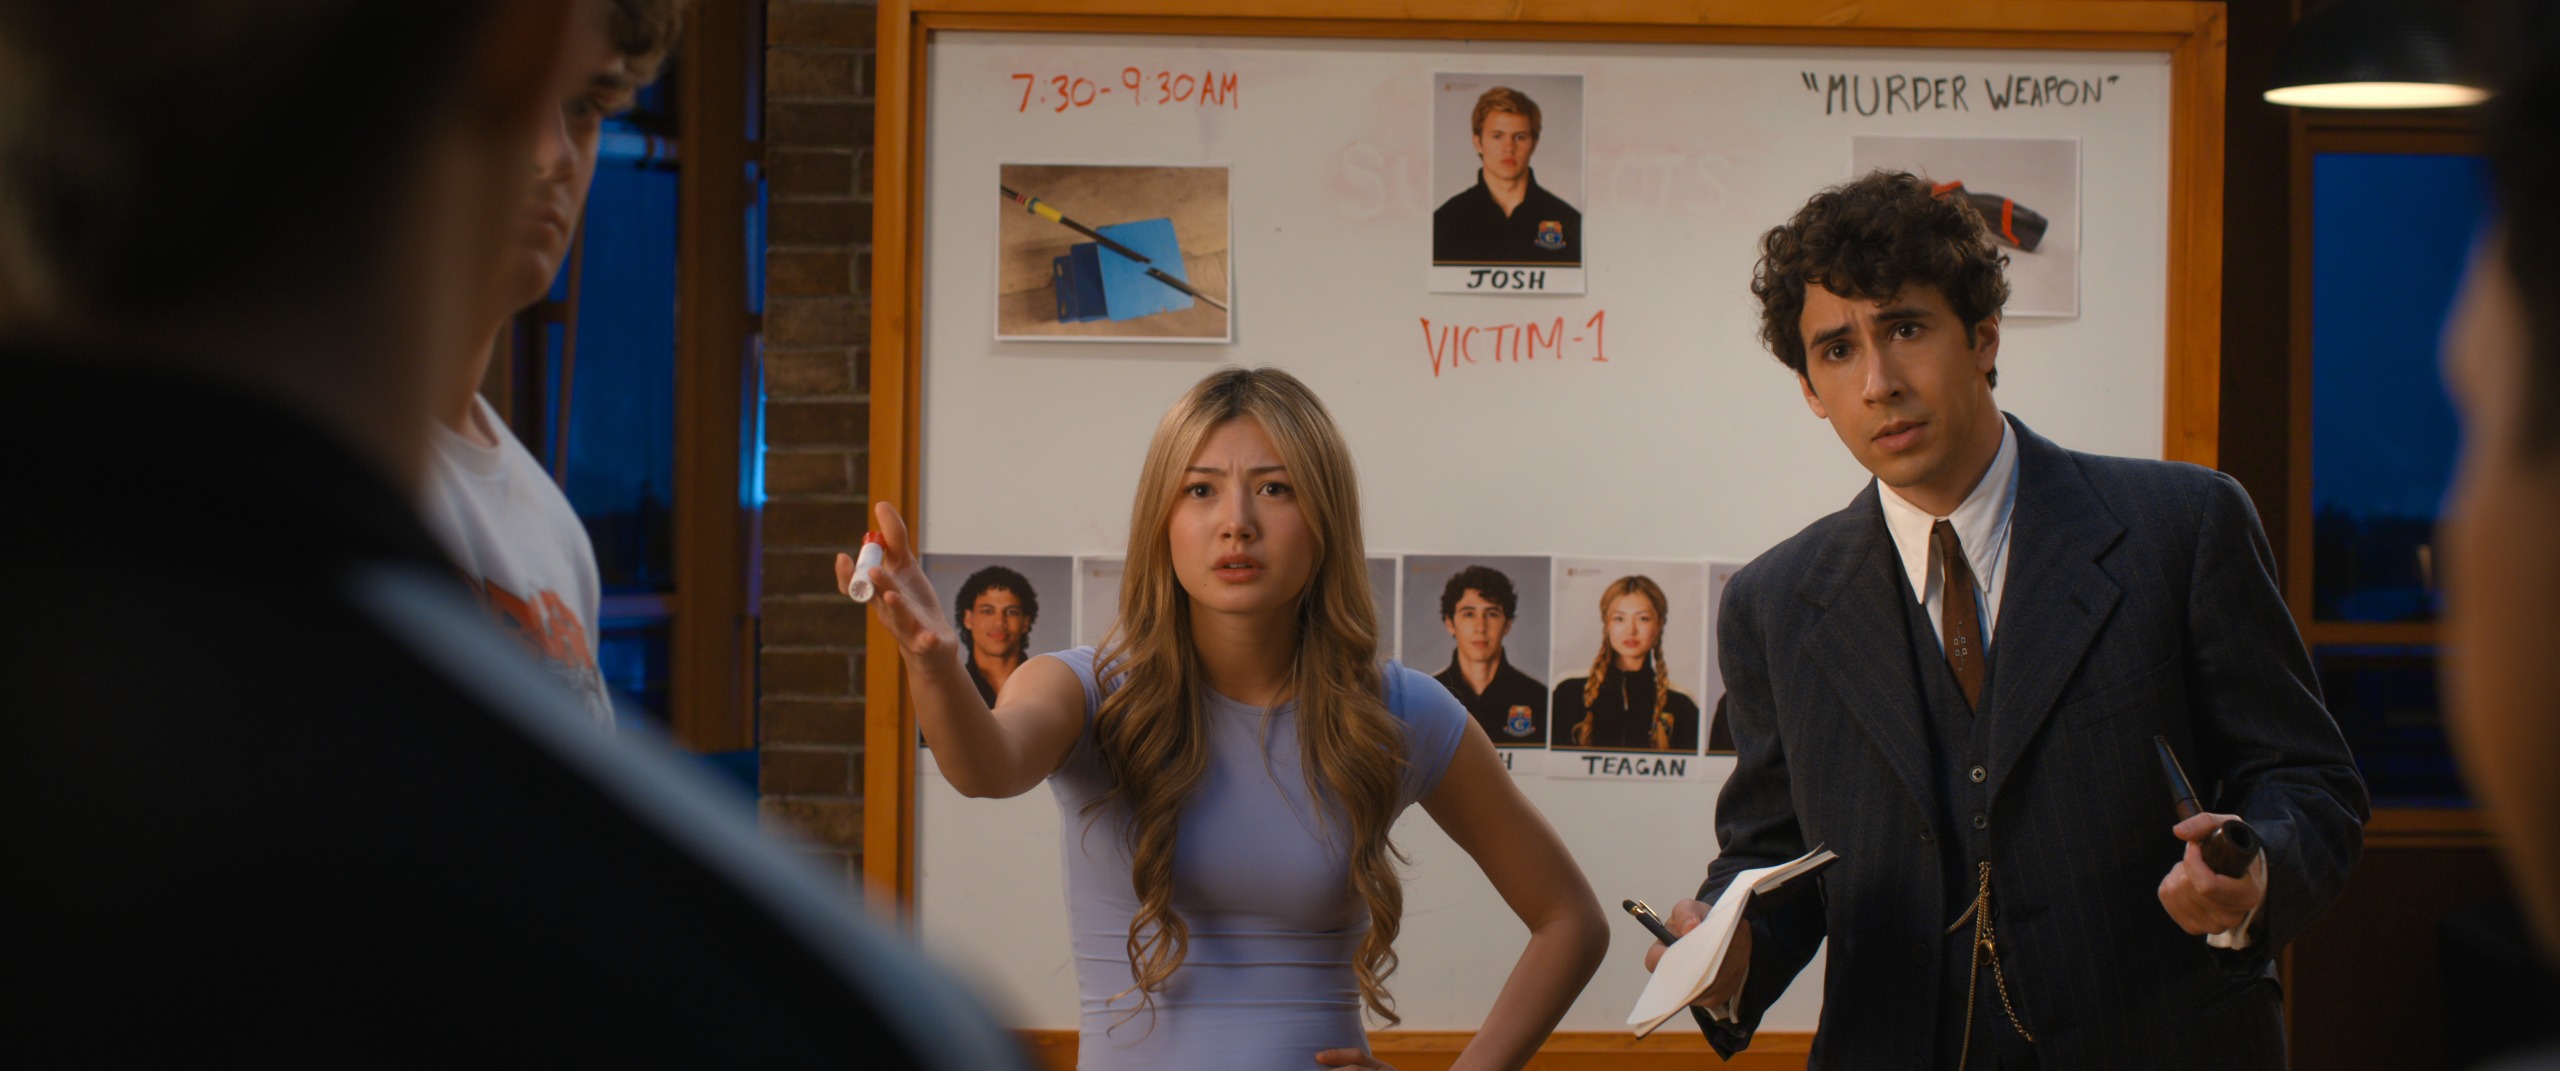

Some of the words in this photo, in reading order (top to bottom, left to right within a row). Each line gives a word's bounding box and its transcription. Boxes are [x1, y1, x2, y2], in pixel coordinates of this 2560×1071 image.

[1466, 269, 1546, 291] JOSH
[1420, 310, 1609, 377] VICTIM-1
[1581, 755, 1686, 777] TEAGAN
